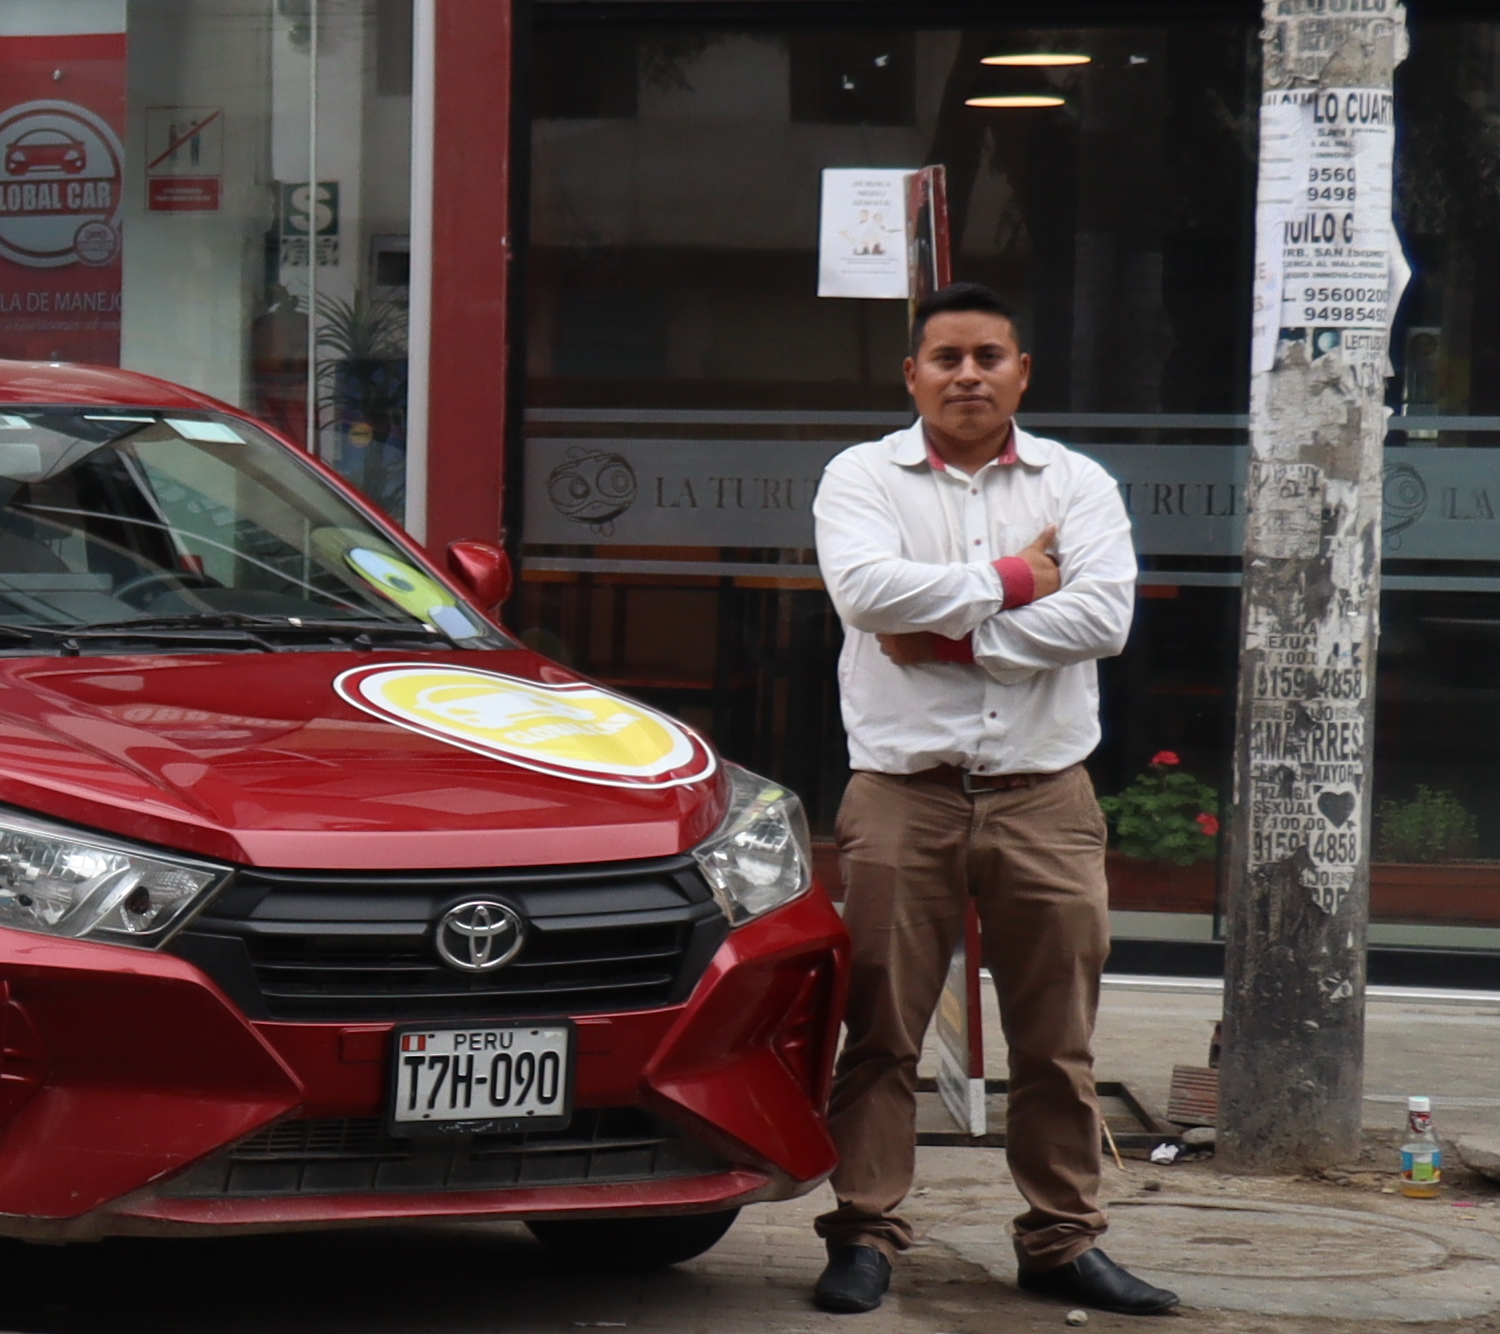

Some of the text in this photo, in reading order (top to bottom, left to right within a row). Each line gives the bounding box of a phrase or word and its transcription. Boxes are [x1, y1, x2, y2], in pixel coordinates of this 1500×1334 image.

[66, 181, 112, 209] CAR
[288, 184, 333, 233] S
[1315, 248, 1344, 258] SAN
[27, 292, 50, 311] DE
[655, 476, 699, 509] LA
[1253, 801, 1317, 816] SEXUAL
[452, 1031, 515, 1052] PERU
[403, 1050, 561, 1112] T7H-090
